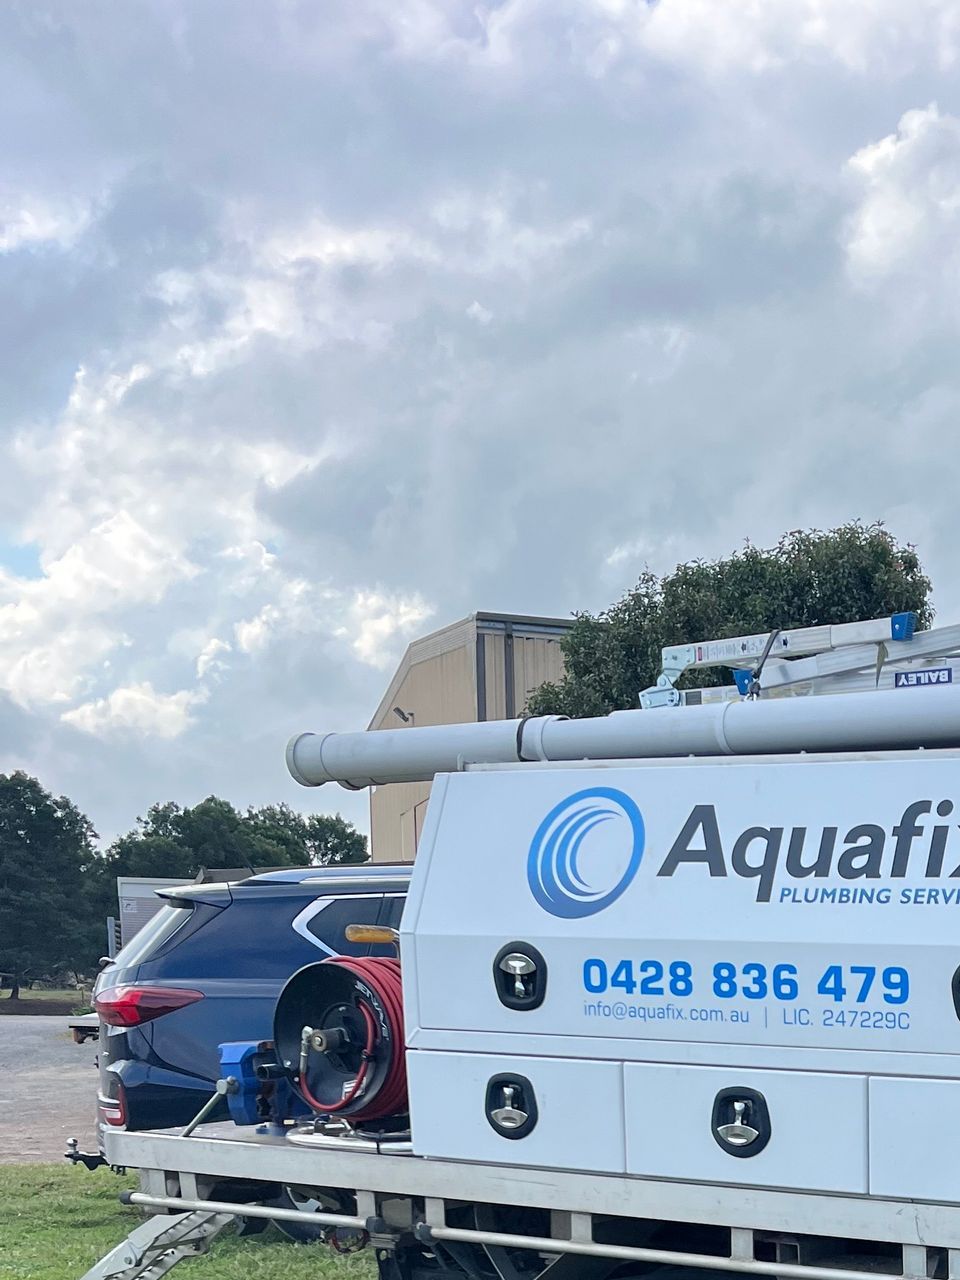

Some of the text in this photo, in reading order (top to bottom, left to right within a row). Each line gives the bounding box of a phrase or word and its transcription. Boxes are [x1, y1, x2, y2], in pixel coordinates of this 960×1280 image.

[899, 671, 948, 686] BAILEY
[779, 887, 892, 904] PLUMBING
[582, 958, 910, 1006] 0428 836 479
[583, 1000, 911, 1030] info@aquafix.com.au LIC. 247229C
